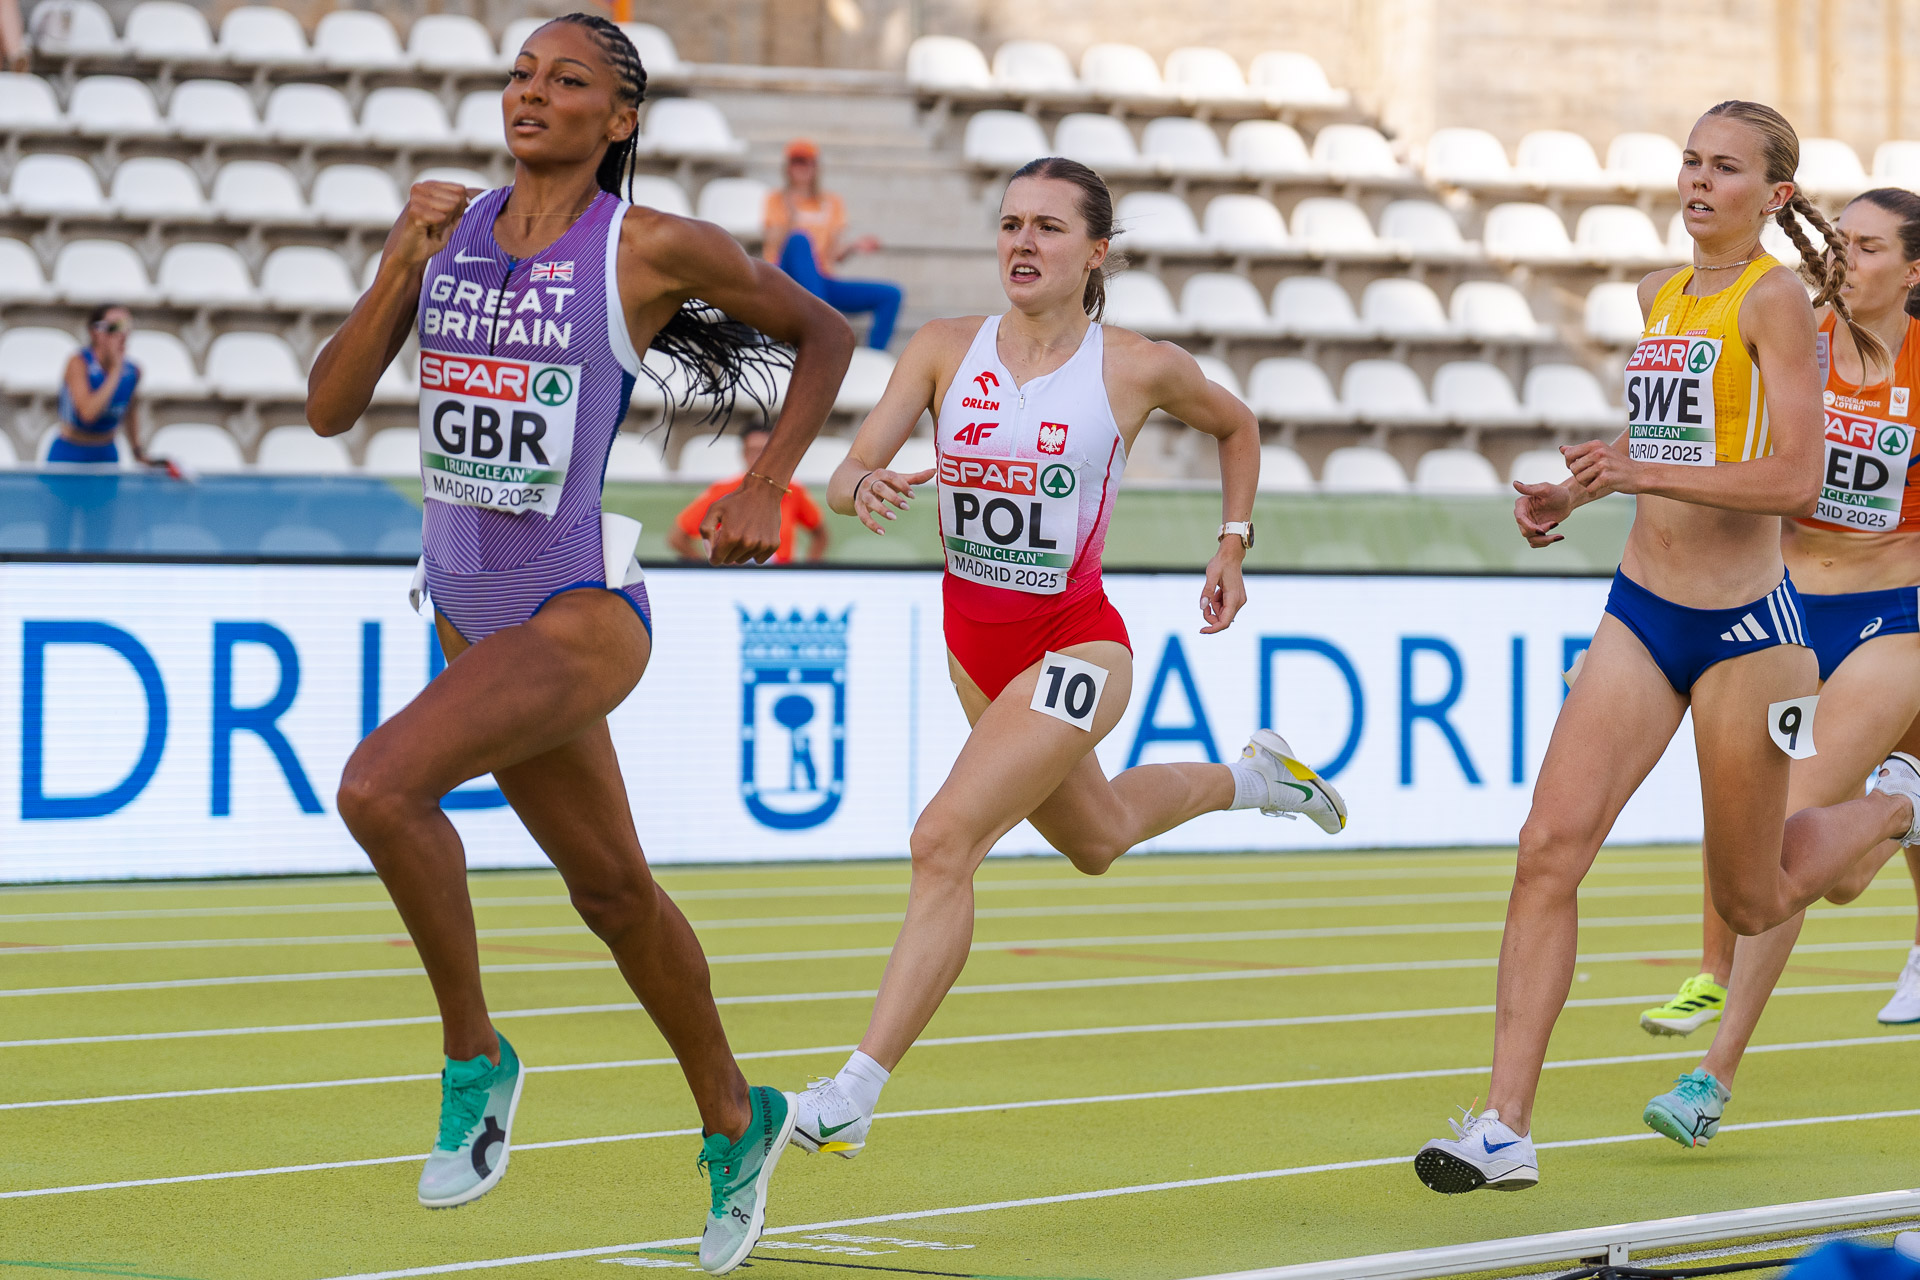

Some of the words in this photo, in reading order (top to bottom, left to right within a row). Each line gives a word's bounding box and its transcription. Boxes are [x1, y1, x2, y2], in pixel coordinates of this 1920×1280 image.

[430, 274, 576, 316] GREAT
[424, 307, 572, 349] BRITAIN
[1629, 343, 1685, 367] SPAR
[421, 356, 526, 398] SPAR
[962, 397, 1000, 411] ORLEN
[1628, 376, 1702, 425] SWE
[1836, 395, 1880, 408] NEDERLANDSE
[433, 400, 550, 466] GBR
[954, 422, 999, 446] 4F
[1634, 425, 1648, 438] RUN
[1825, 414, 1874, 446] AR
[444, 458, 448, 469] I
[449, 459, 473, 476] RUN
[1662, 445, 1702, 462] 2025
[1825, 446, 1889, 491] ED
[433, 475, 493, 504] MADRID
[497, 488, 545, 506] 2025
[941, 458, 1033, 491] SPAR
[953, 492, 1057, 549] POL
[1847, 510, 1887, 527] 2025
[964, 541, 968, 553] I
[969, 544, 991, 558] RUN
[954, 555, 1010, 583] MADRID
[1015, 570, 1058, 588] 2025
[1044, 665, 1097, 719] 10
[1124, 634, 1594, 787] ADRI
[1778, 706, 1802, 750] 9
